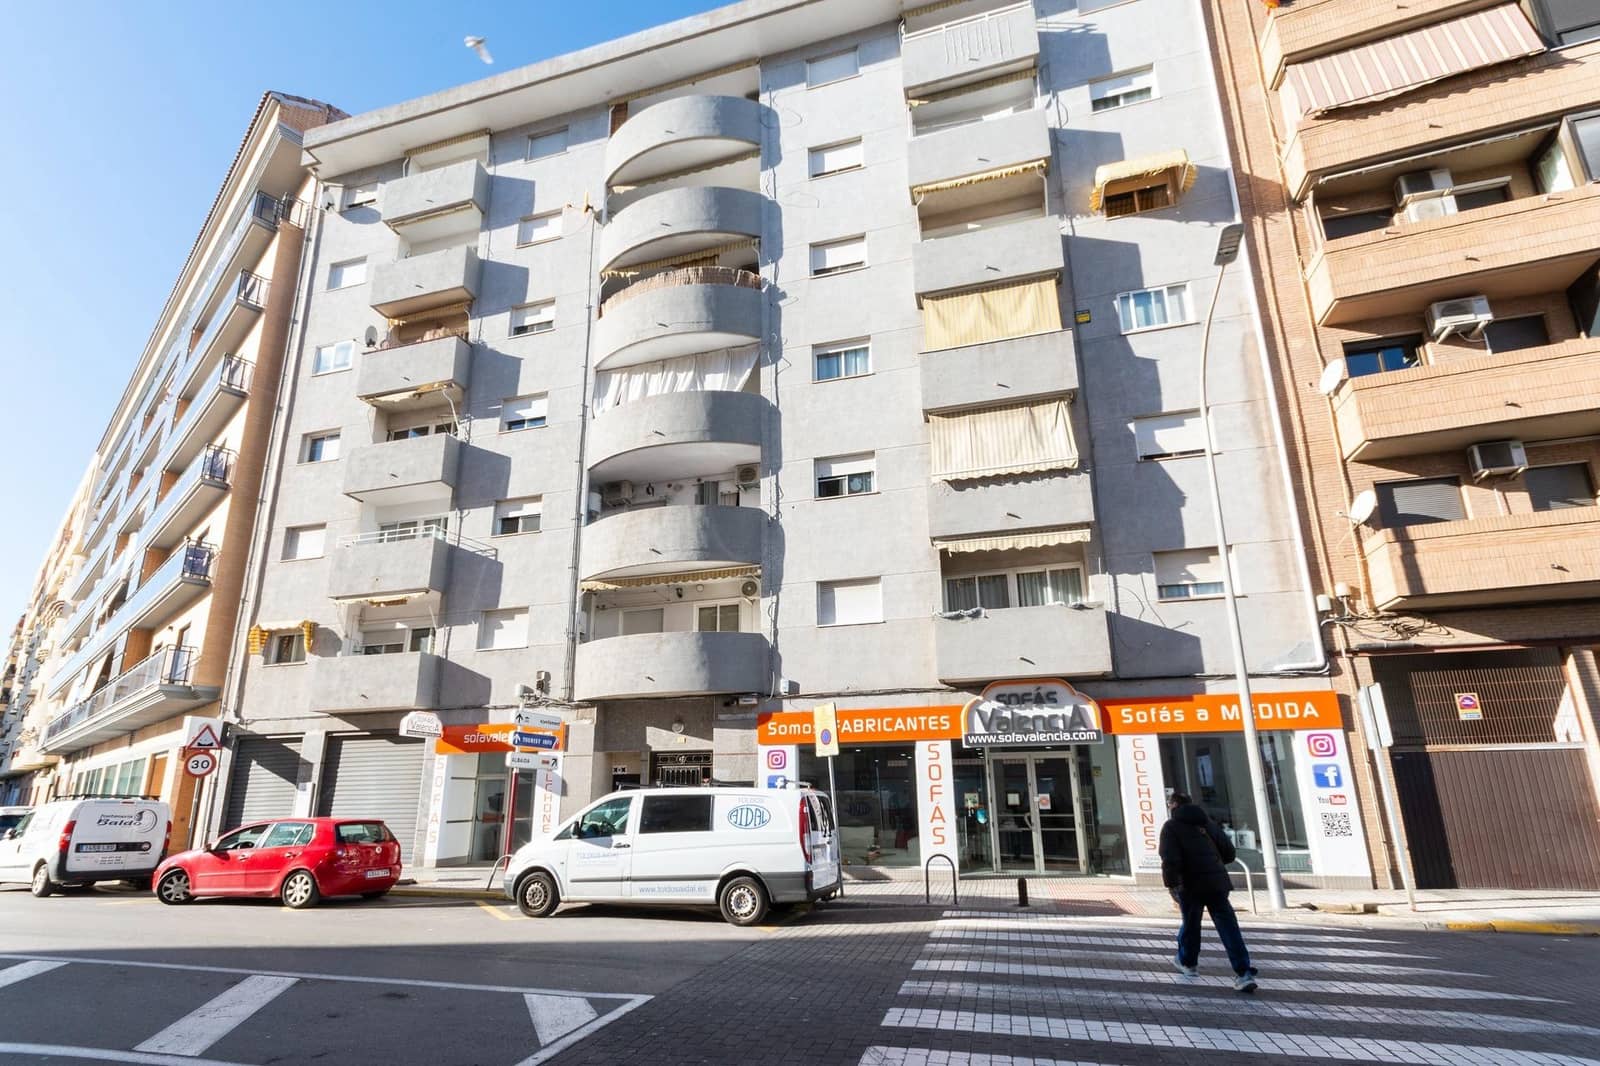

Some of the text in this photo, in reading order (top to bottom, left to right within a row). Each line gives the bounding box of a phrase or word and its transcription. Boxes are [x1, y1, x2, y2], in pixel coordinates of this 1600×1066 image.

[995, 686, 1058, 708] SOFÁS
[1121, 701, 1320, 724] Sofás a MDIDA
[967, 730, 1097, 744] www.sofavalencia.com
[191, 759, 210, 769] 30
[927, 743, 946, 845] SOFÁS
[1132, 738, 1157, 851] COLCHONES
[96, 818, 143, 827] Baldo
[730, 807, 768, 827] AIDAL
